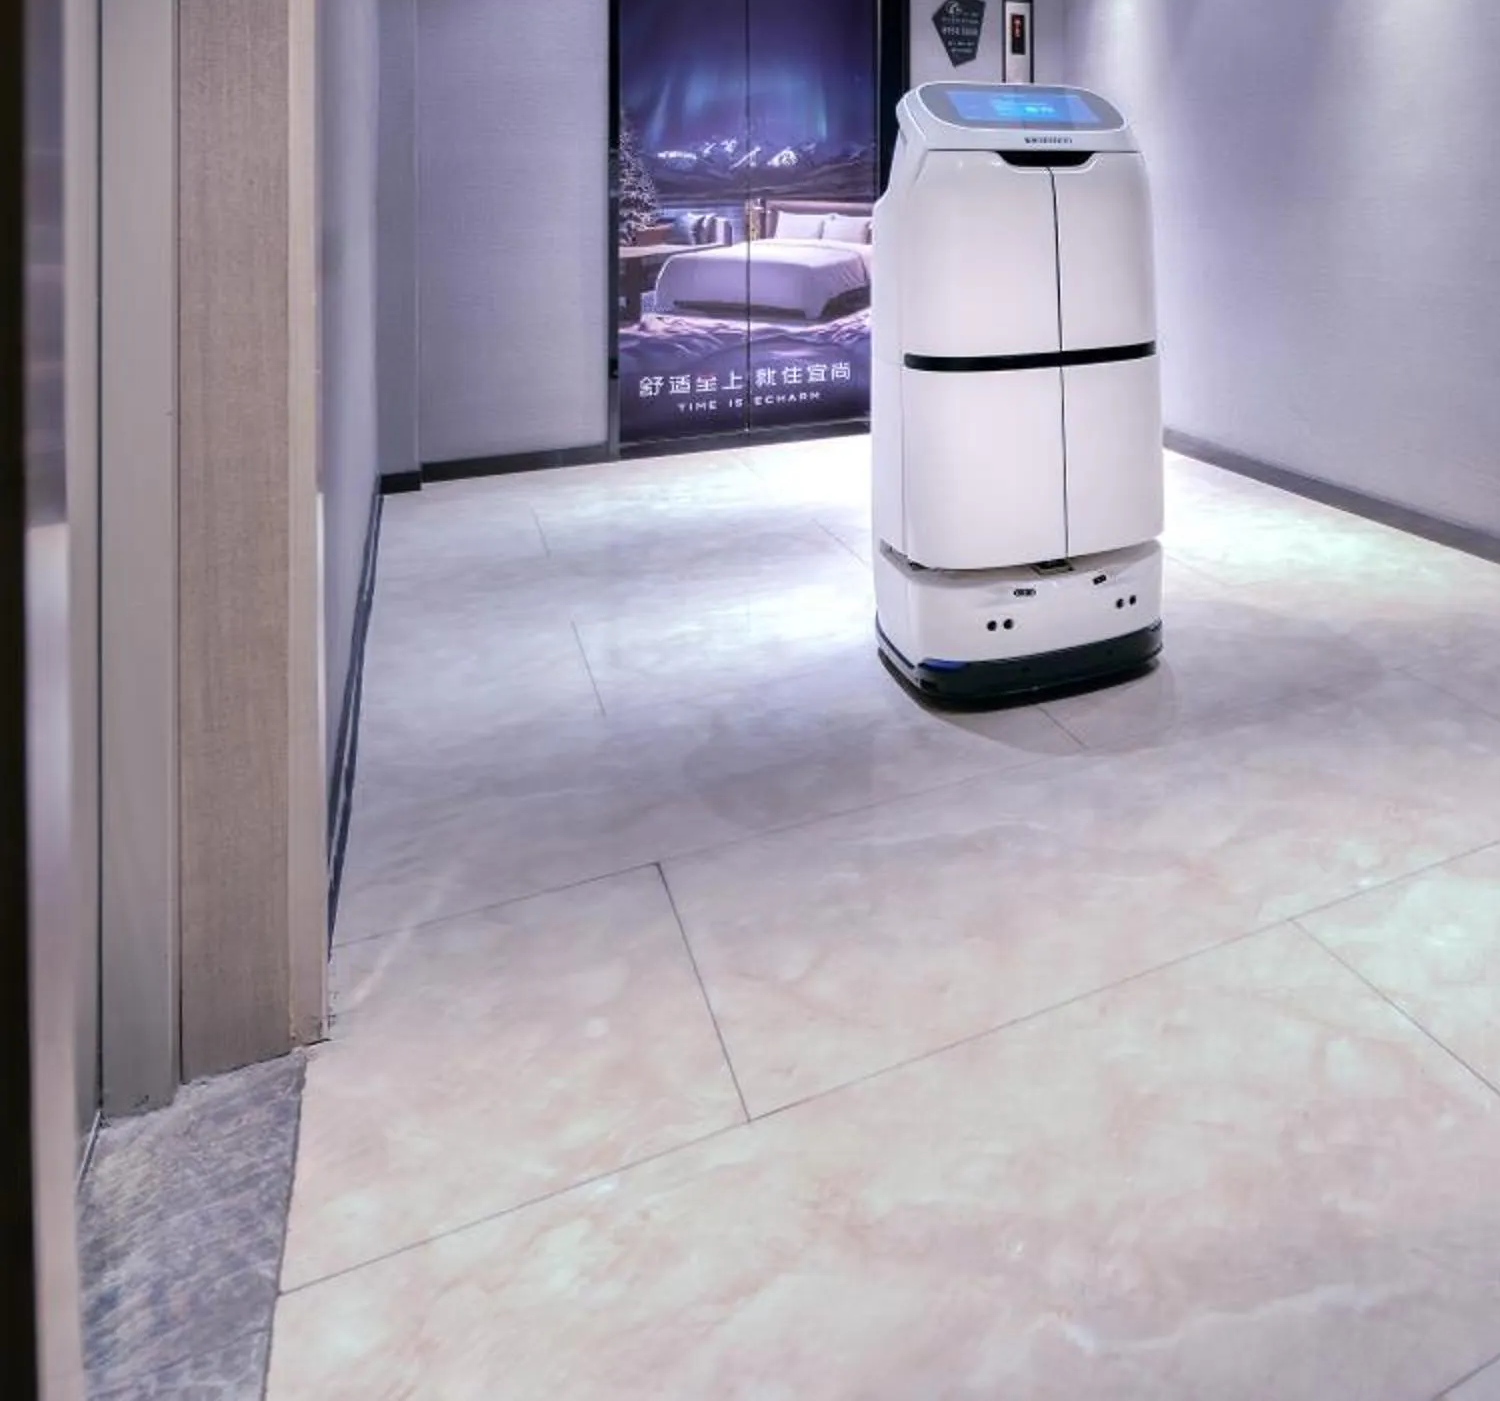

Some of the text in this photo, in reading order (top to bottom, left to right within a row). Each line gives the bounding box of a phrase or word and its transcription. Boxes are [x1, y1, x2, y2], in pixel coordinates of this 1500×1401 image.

[677, 391, 820, 412] TIME IS ECHARM
